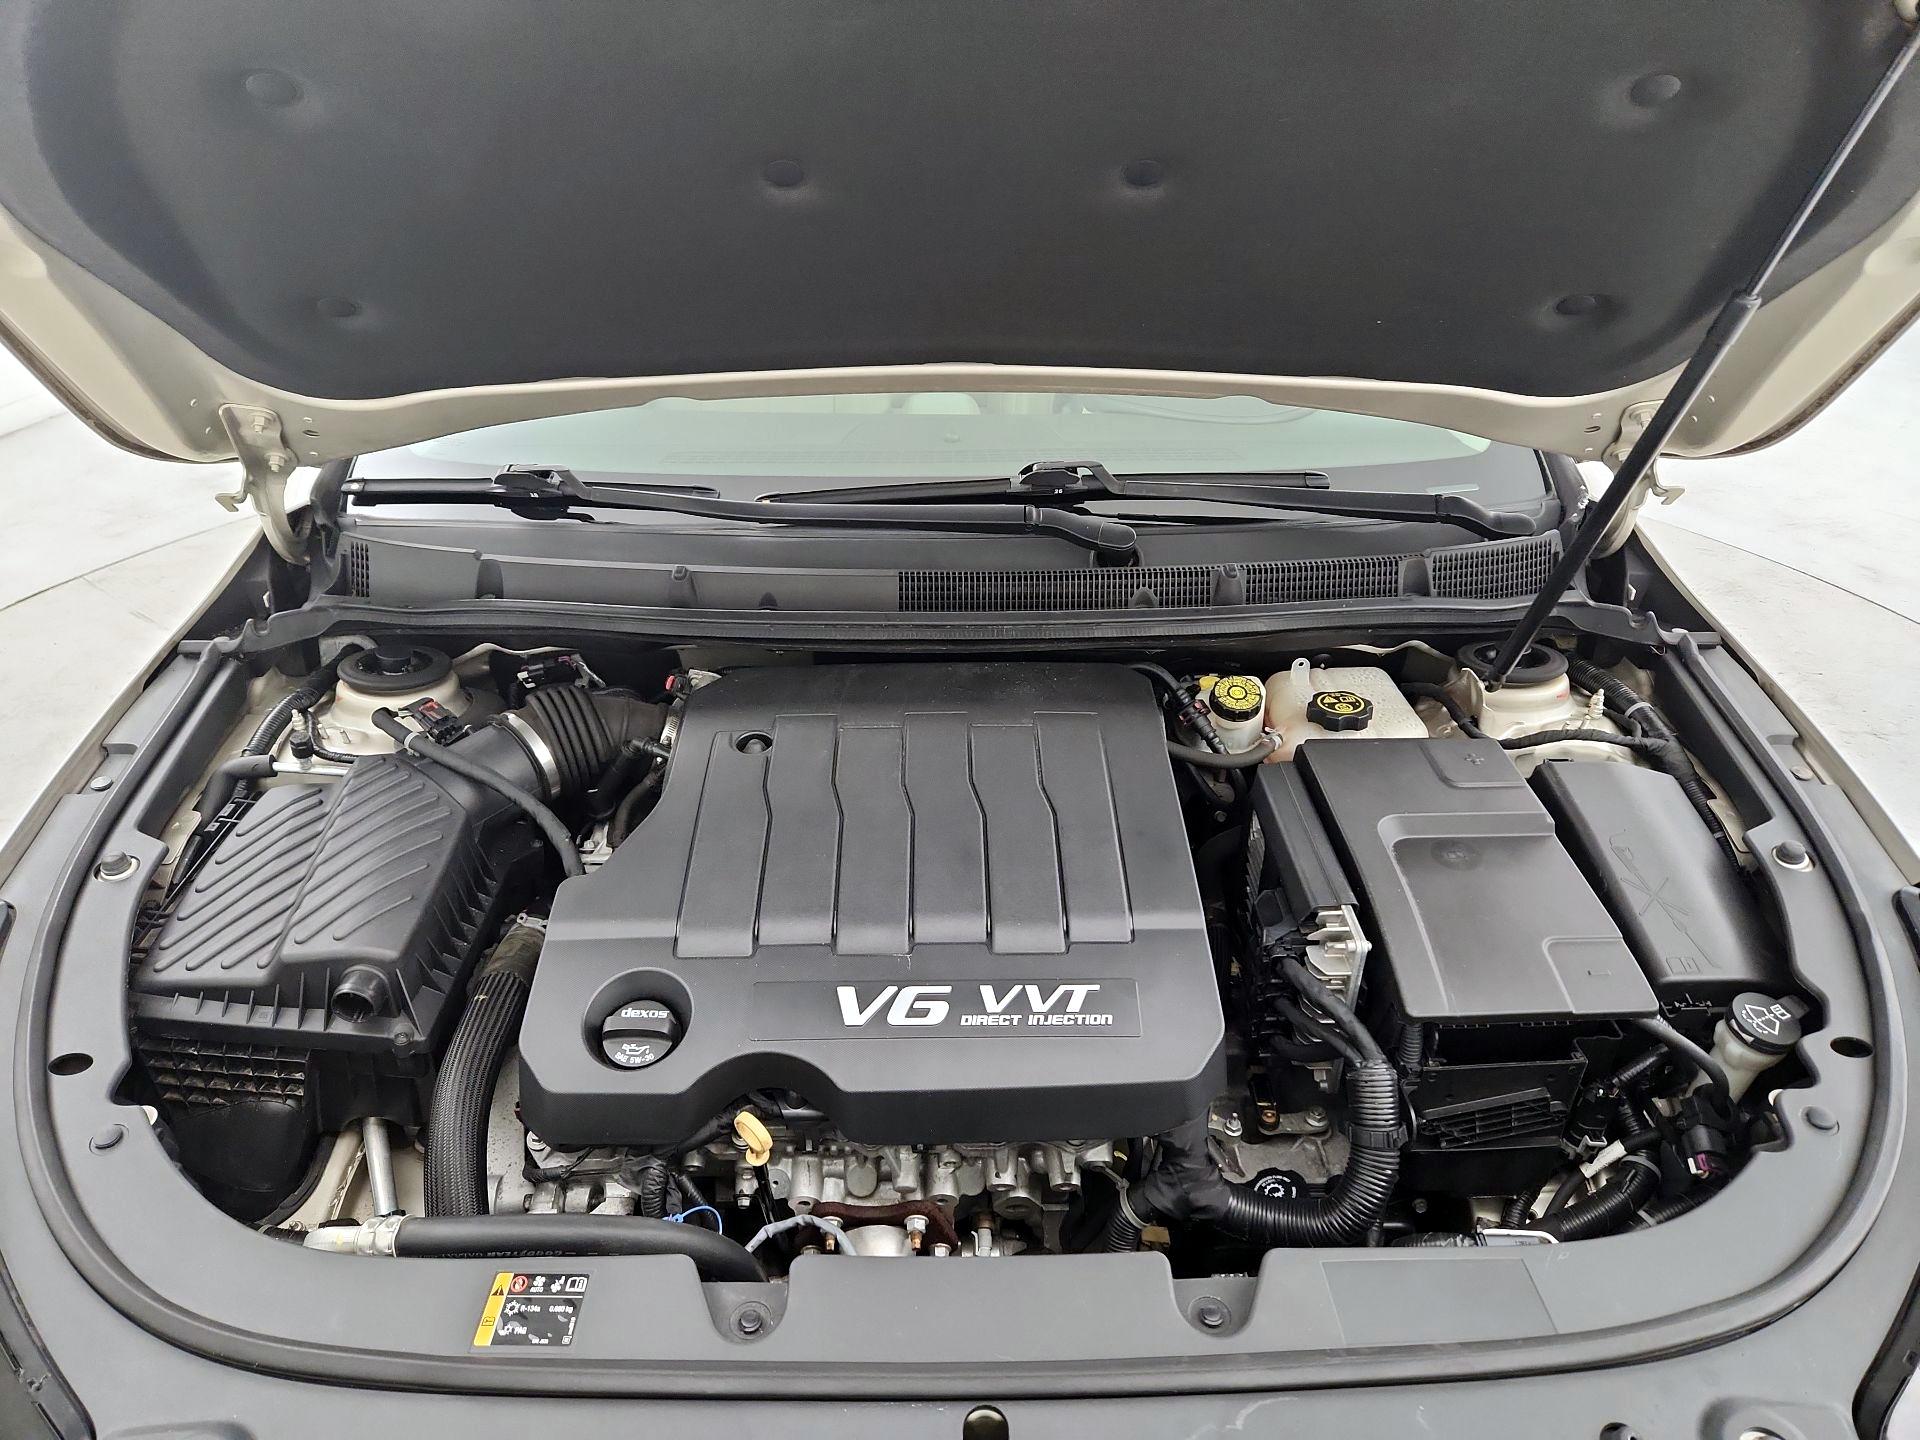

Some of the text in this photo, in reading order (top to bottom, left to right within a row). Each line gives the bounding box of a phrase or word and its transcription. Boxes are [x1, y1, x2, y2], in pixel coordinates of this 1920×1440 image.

[836, 984, 1101, 1027] V6 VVT
[620, 1007, 670, 1019] dexos
[960, 1014, 1113, 1026] DIRECT INJECTION
[615, 1051, 655, 1064] SAE 5W-30
